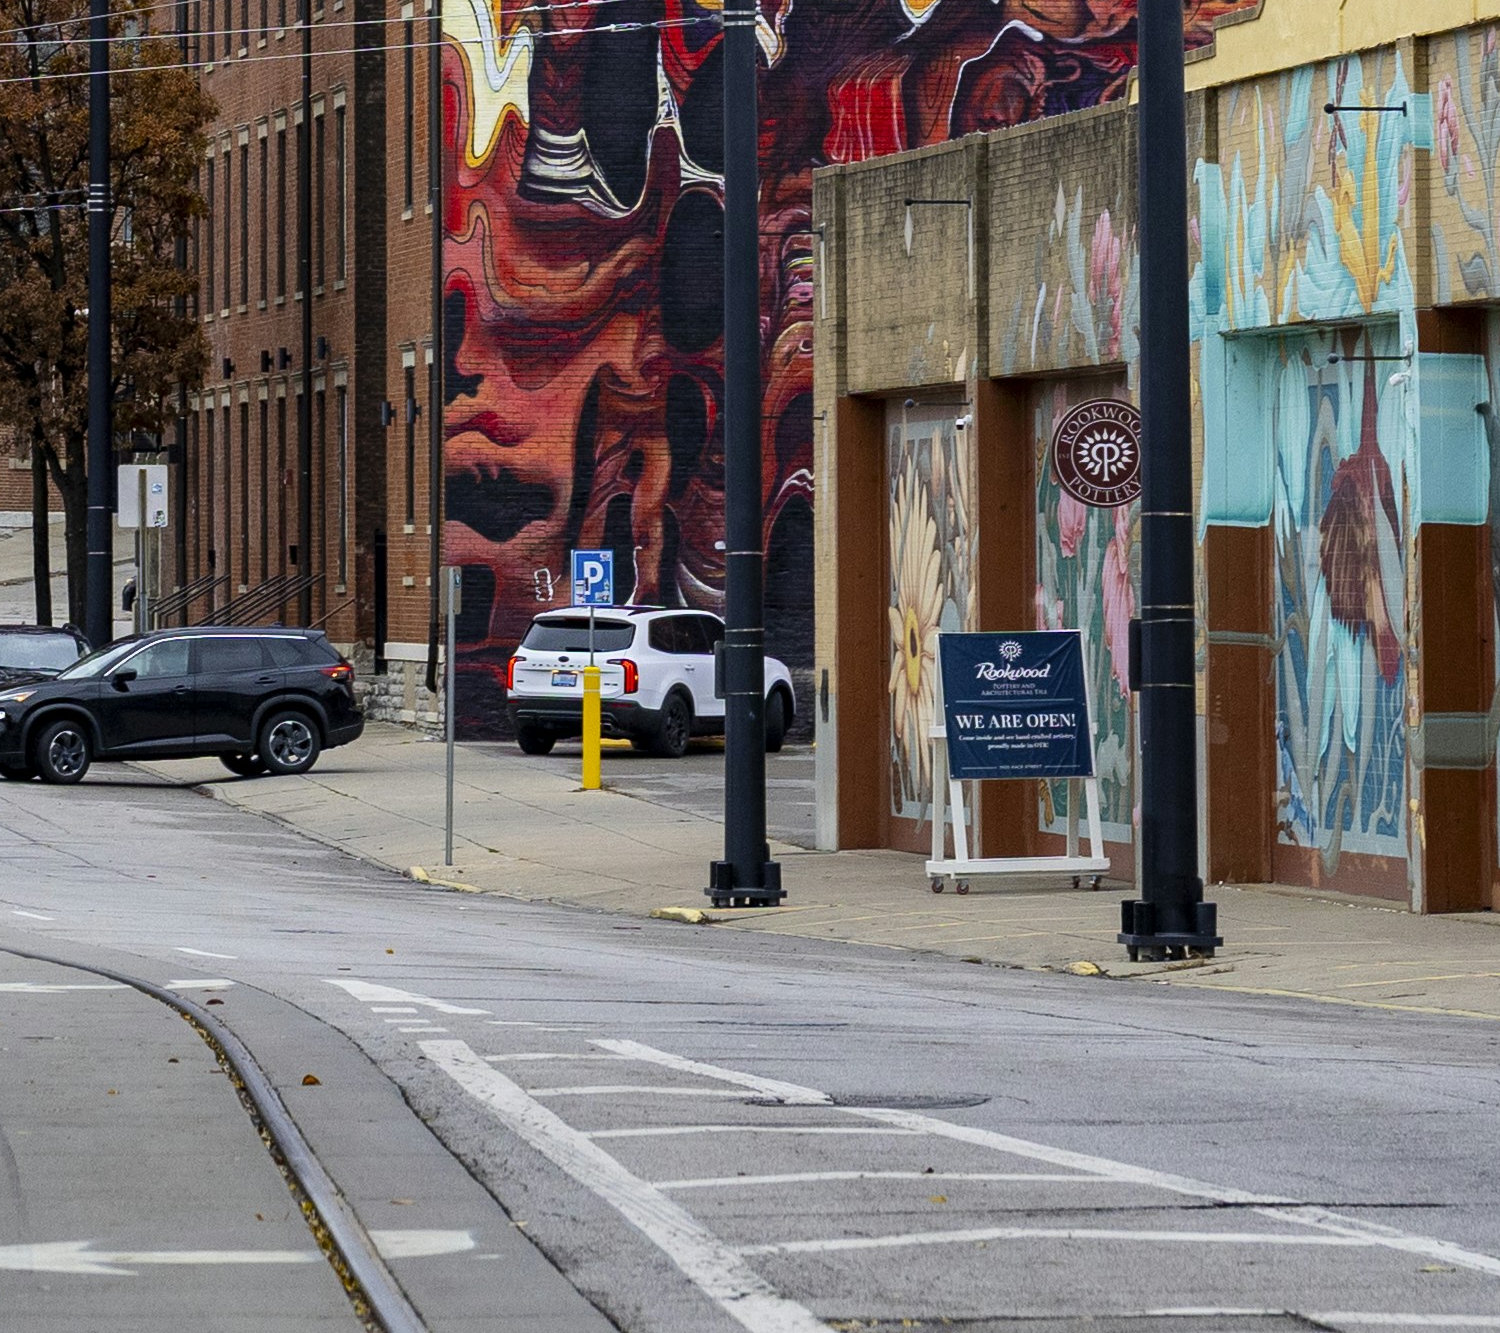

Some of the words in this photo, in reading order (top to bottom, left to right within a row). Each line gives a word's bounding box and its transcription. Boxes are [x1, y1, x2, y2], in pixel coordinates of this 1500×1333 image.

[1060, 405, 1141, 445] ROOKWOO
[974, 661, 1051, 681] Rookwood
[955, 714, 985, 729] WE
[988, 714, 1023, 729] ARE
[1027, 713, 1077, 728] OPEN!
